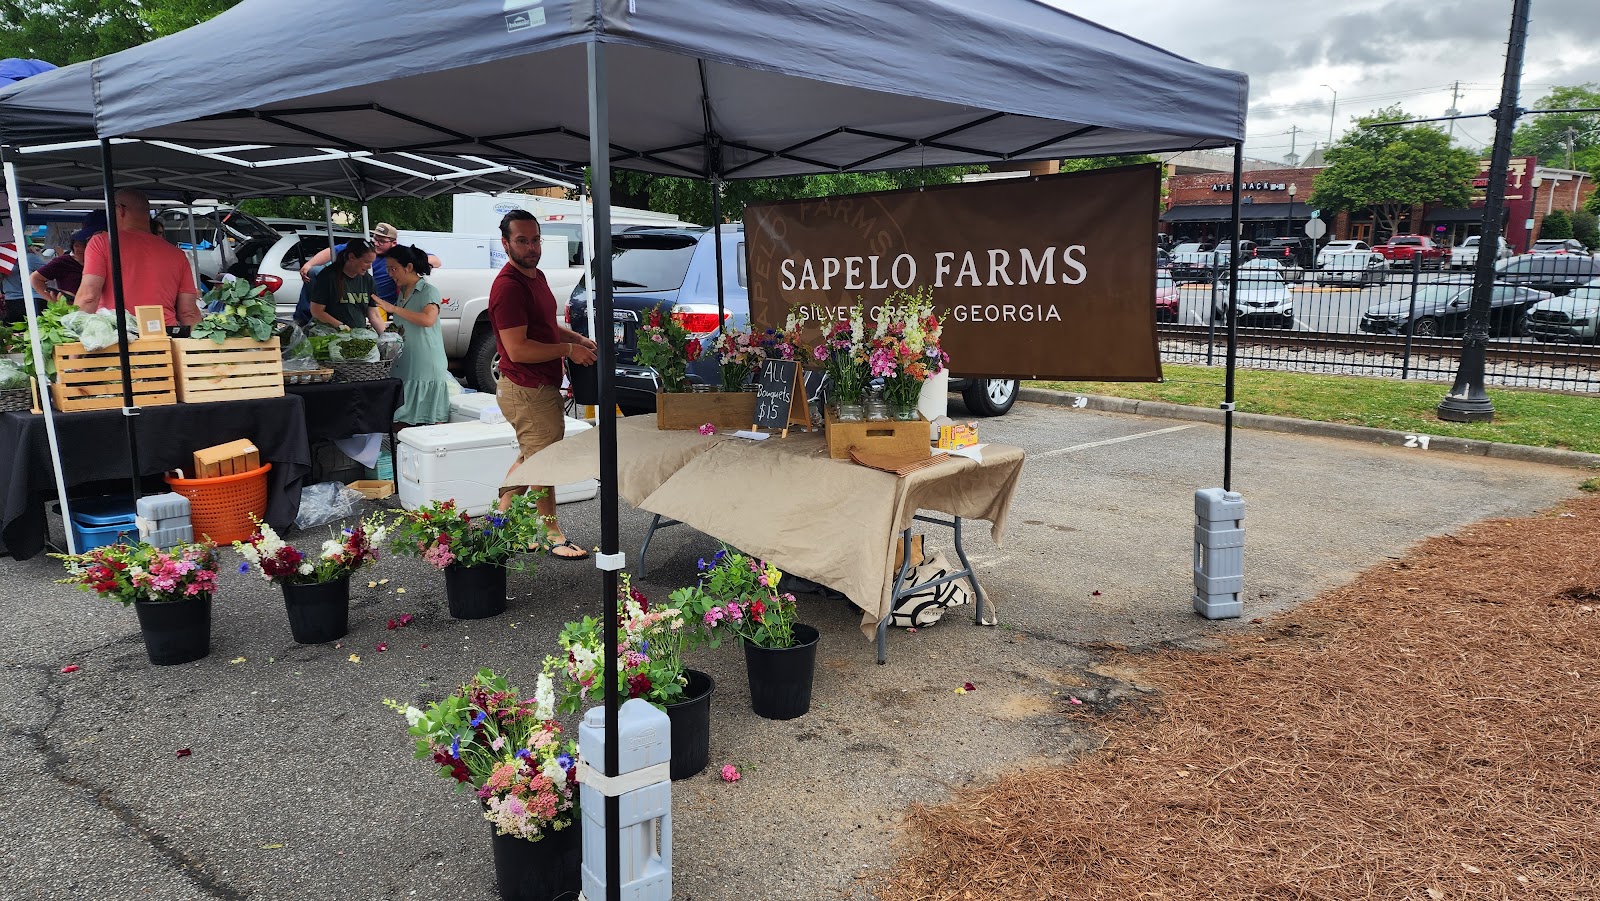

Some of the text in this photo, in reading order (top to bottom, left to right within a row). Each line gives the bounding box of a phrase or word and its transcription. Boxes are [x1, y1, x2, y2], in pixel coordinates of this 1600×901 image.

[781, 245, 1087, 291] SAPELO FARMS
[953, 304, 1062, 322] GEORGIA
[764, 360, 787, 383] ALL
[757, 383, 790, 405] Bouquets
[758, 401, 779, 421] $15
[1403, 435, 1431, 450] 29
